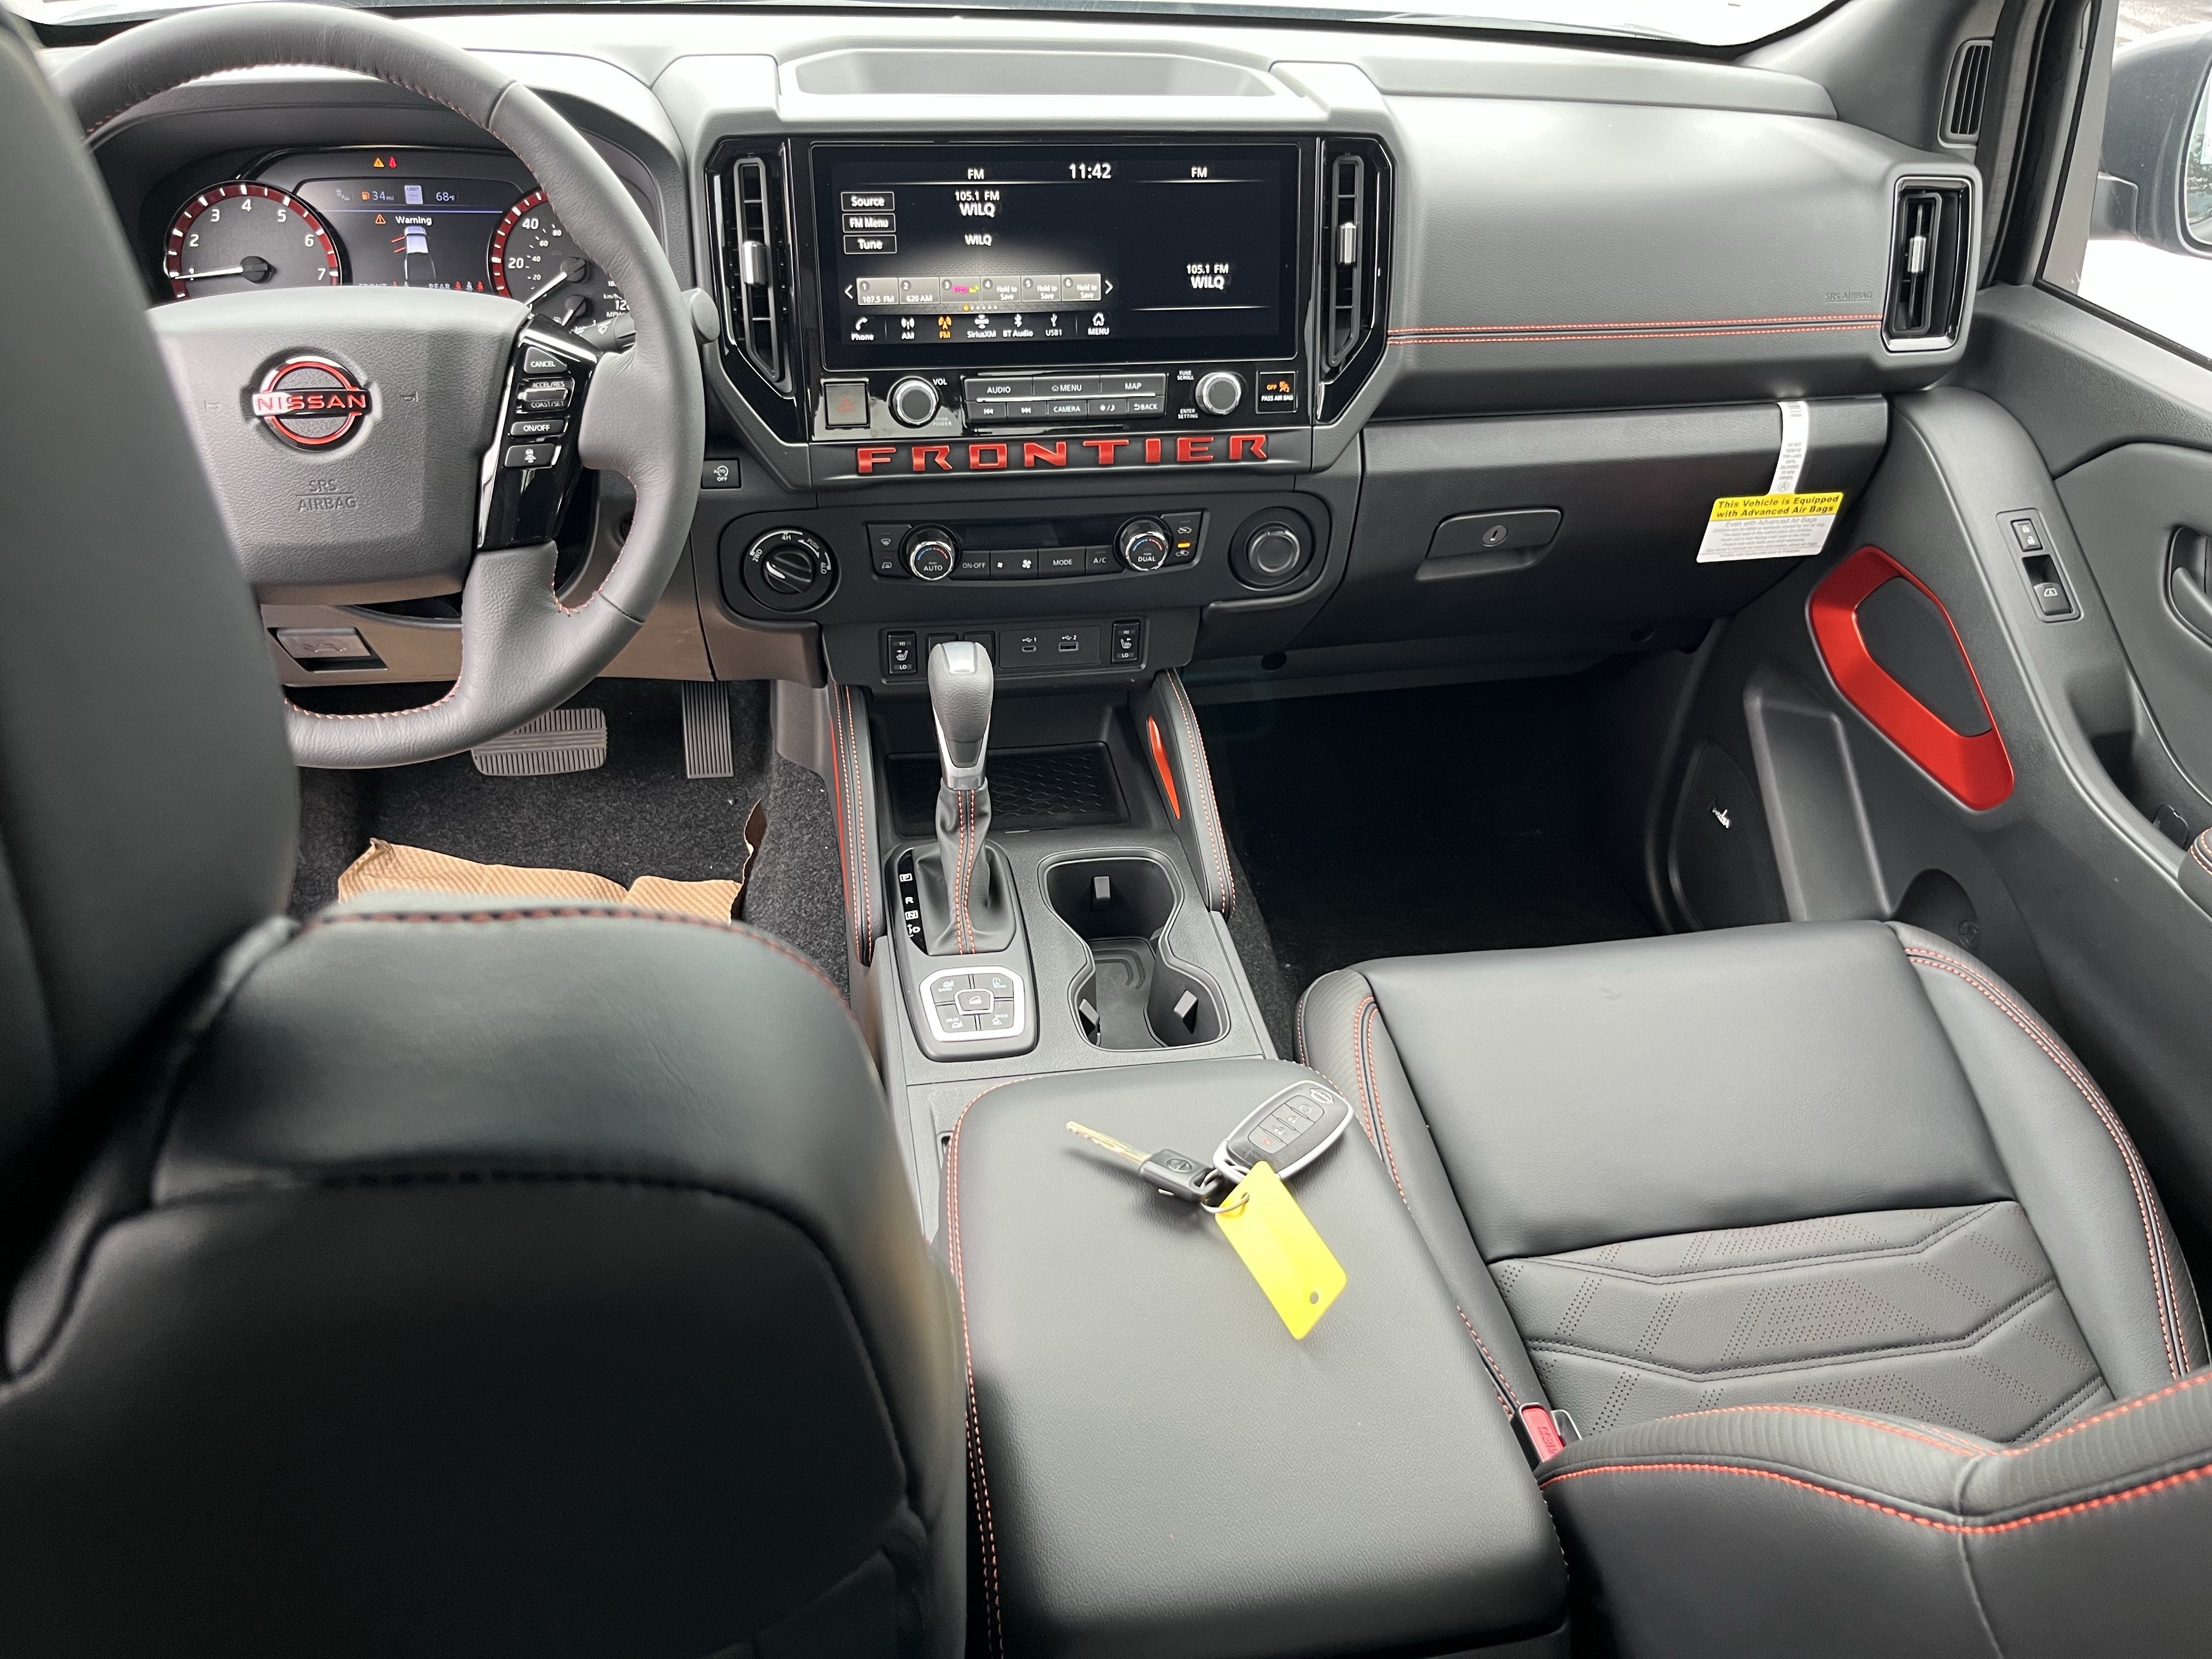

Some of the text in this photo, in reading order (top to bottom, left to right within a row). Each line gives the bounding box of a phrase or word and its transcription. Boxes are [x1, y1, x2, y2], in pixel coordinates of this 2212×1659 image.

[968, 168, 984, 180] FM
[1069, 163, 1111, 179] 11:42
[1191, 167, 1207, 178] FM
[851, 195, 885, 207] Source
[955, 190, 1000, 201] 105.1 FM
[241, 199, 252, 212] 4
[960, 202, 995, 217] WILQ
[211, 210, 219, 222] 3
[278, 210, 286, 222] 5
[396, 216, 432, 225] Warning
[522, 218, 539, 230] 40
[850, 217, 889, 228] FM Menu
[190, 234, 199, 247] 2
[304, 235, 314, 247] 6
[857, 238, 883, 250] Tune
[964, 234, 992, 247] WILQ
[509, 257, 524, 269] 20
[1187, 264, 1229, 274] 105.1 FM
[317, 268, 326, 280] 7
[1190, 276, 1224, 290] WILQ
[1012, 329, 1034, 337] Audio
[1087, 328, 1110, 336] MENU
[1060, 384, 1082, 392] MENU
[257, 394, 366, 411] NISSAN
[1053, 405, 1081, 414] CAMERA
[857, 434, 1267, 473] FRONTIER
[309, 479, 336, 493] SRS
[297, 497, 358, 512] AIRBAG
[1743, 499, 1779, 507] Vehicle
[1793, 495, 1839, 505] Equipped
[1717, 510, 1737, 518] with
[1741, 506, 1789, 516] Advanced
[1810, 505, 1833, 514] Bags
[806, 538, 820, 550] PUSH
[752, 549, 763, 562] 2WD
